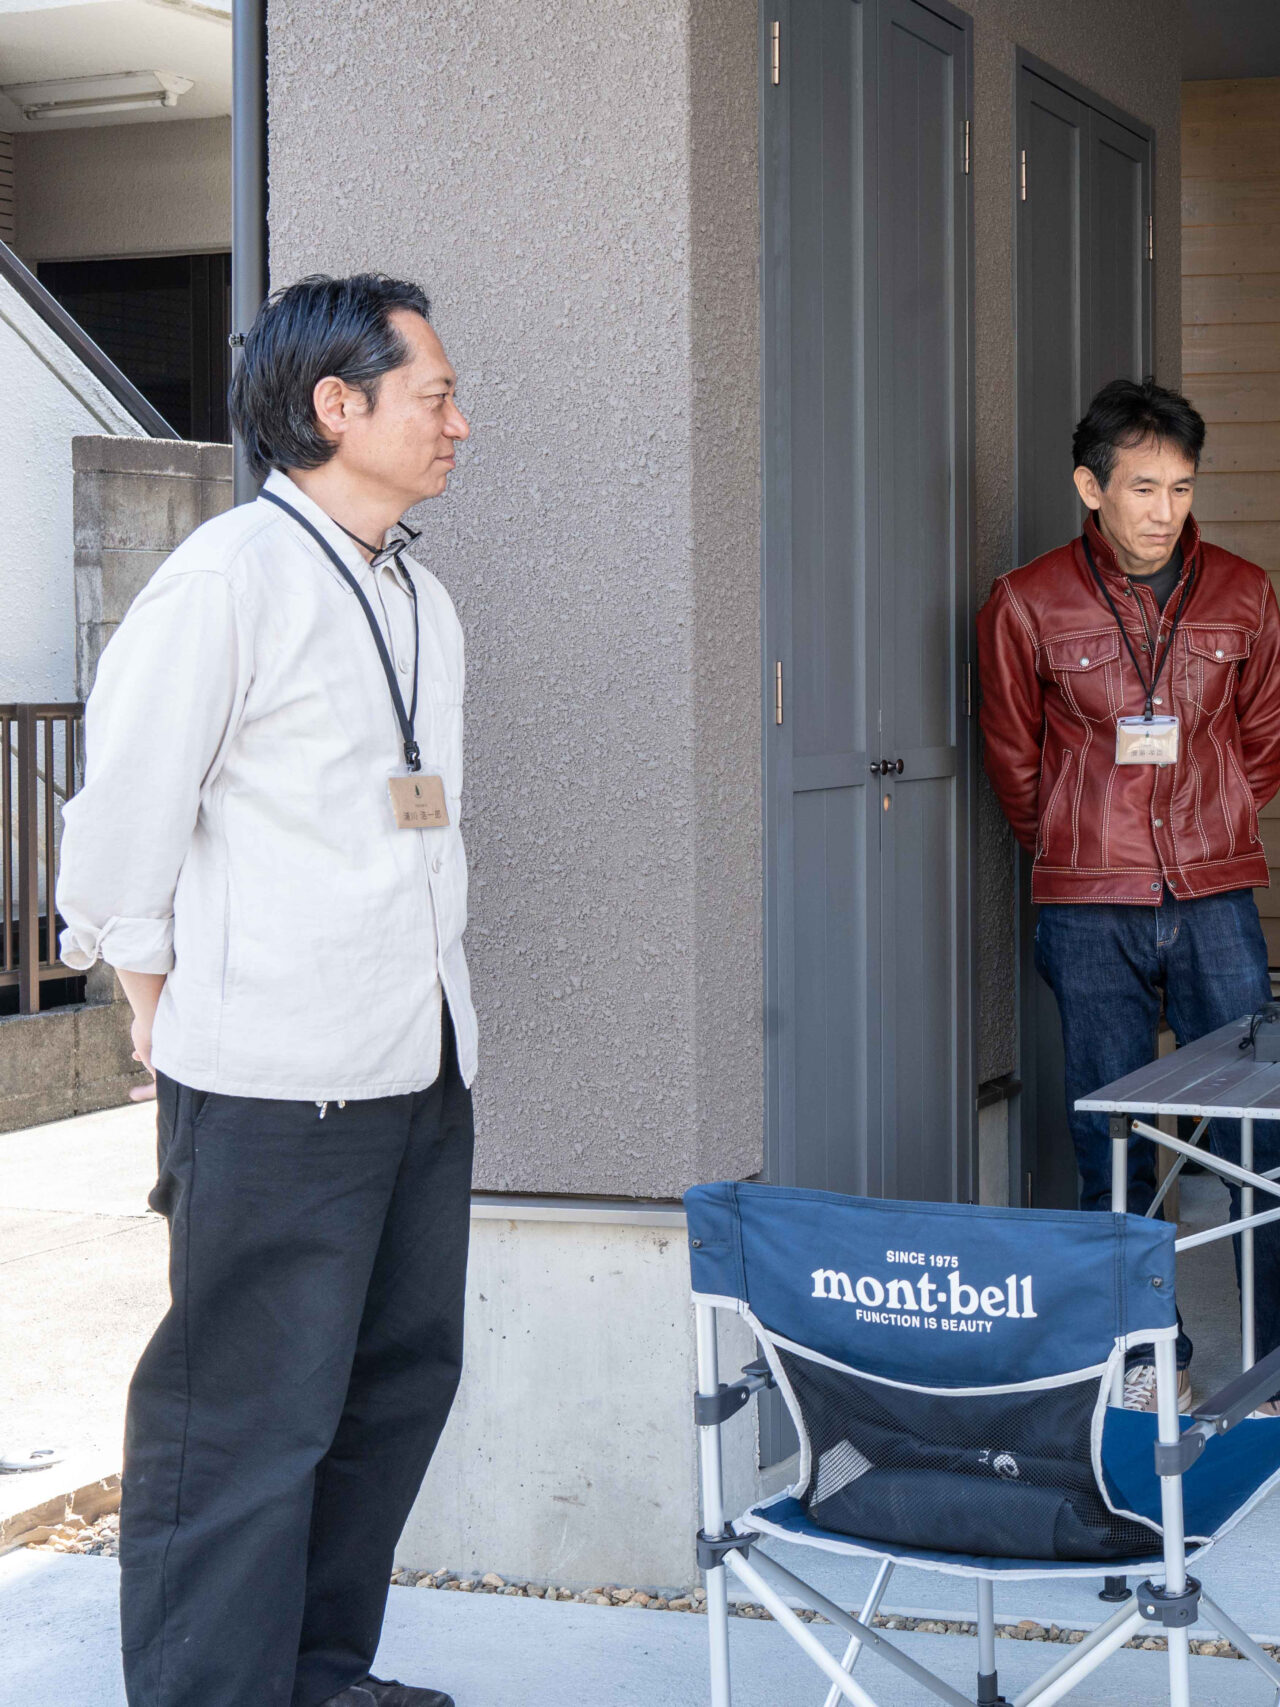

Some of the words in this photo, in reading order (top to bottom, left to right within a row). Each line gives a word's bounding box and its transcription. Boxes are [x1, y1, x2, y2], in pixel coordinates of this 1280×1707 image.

[886, 1249, 926, 1266] SINCE
[929, 1254, 959, 1268] 1975
[855, 1308, 921, 1328] FUNCTION
[924, 1317, 938, 1330] IS
[940, 1318, 993, 1333] BEAUTY
